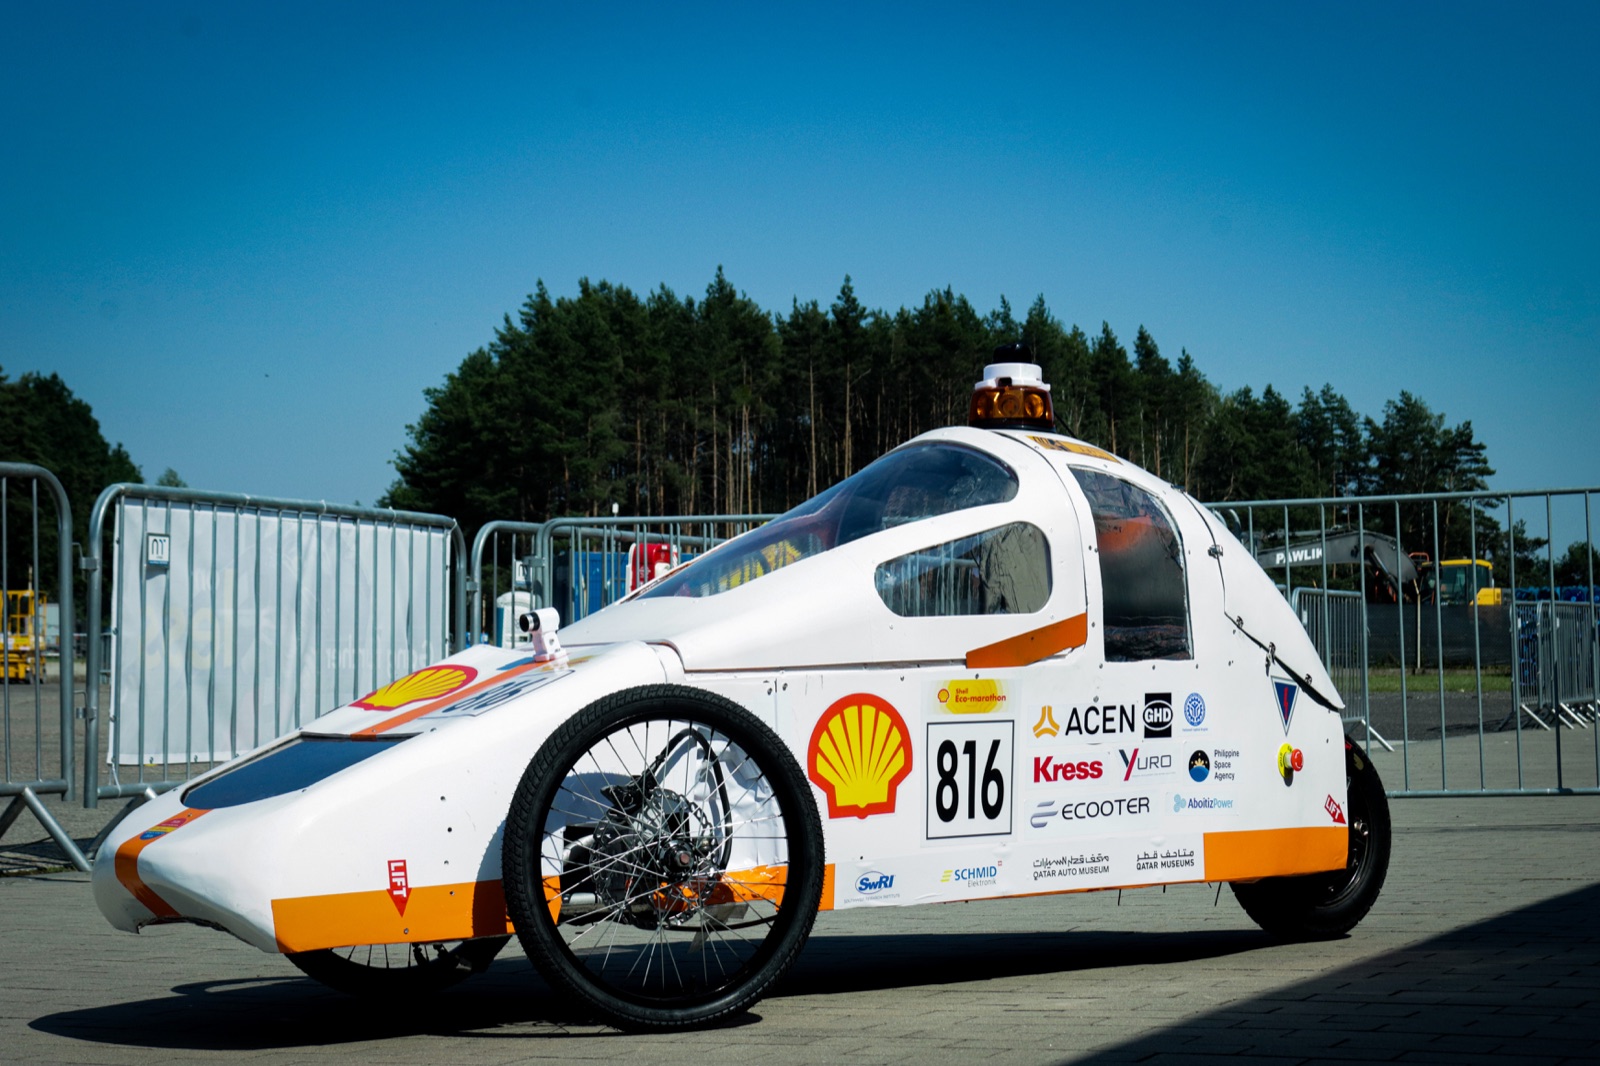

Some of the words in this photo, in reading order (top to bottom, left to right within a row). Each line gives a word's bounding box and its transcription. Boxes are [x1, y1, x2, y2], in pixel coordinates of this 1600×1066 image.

[955, 693, 1007, 703] Eco-marathon
[1064, 704, 1135, 736] ACEN
[1144, 707, 1172, 724] GHD
[1213, 749, 1240, 758] Philippine
[1033, 755, 1104, 784] Kress
[1118, 747, 1172, 782] YURO
[1214, 761, 1231, 770] Space
[935, 739, 1005, 823] 816
[1214, 772, 1235, 781] Agency
[1061, 796, 1150, 820] ECOOTER
[1187, 797, 1234, 809] AboitizPower
[1325, 796, 1341, 820] LIFT
[1136, 850, 1158, 862] قطر
[1160, 848, 1194, 859] متاحف
[1033, 868, 1057, 880] QATAR
[1058, 867, 1078, 877] AUTO
[1078, 865, 1110, 875] MUSEUM
[1136, 861, 1158, 871] QATAR
[1160, 859, 1195, 869] MUSEUMS
[390, 861, 407, 898] LIFT
[954, 865, 997, 882] SCHMID
[858, 874, 895, 891] SwRI
[967, 878, 997, 888] Elektronik
